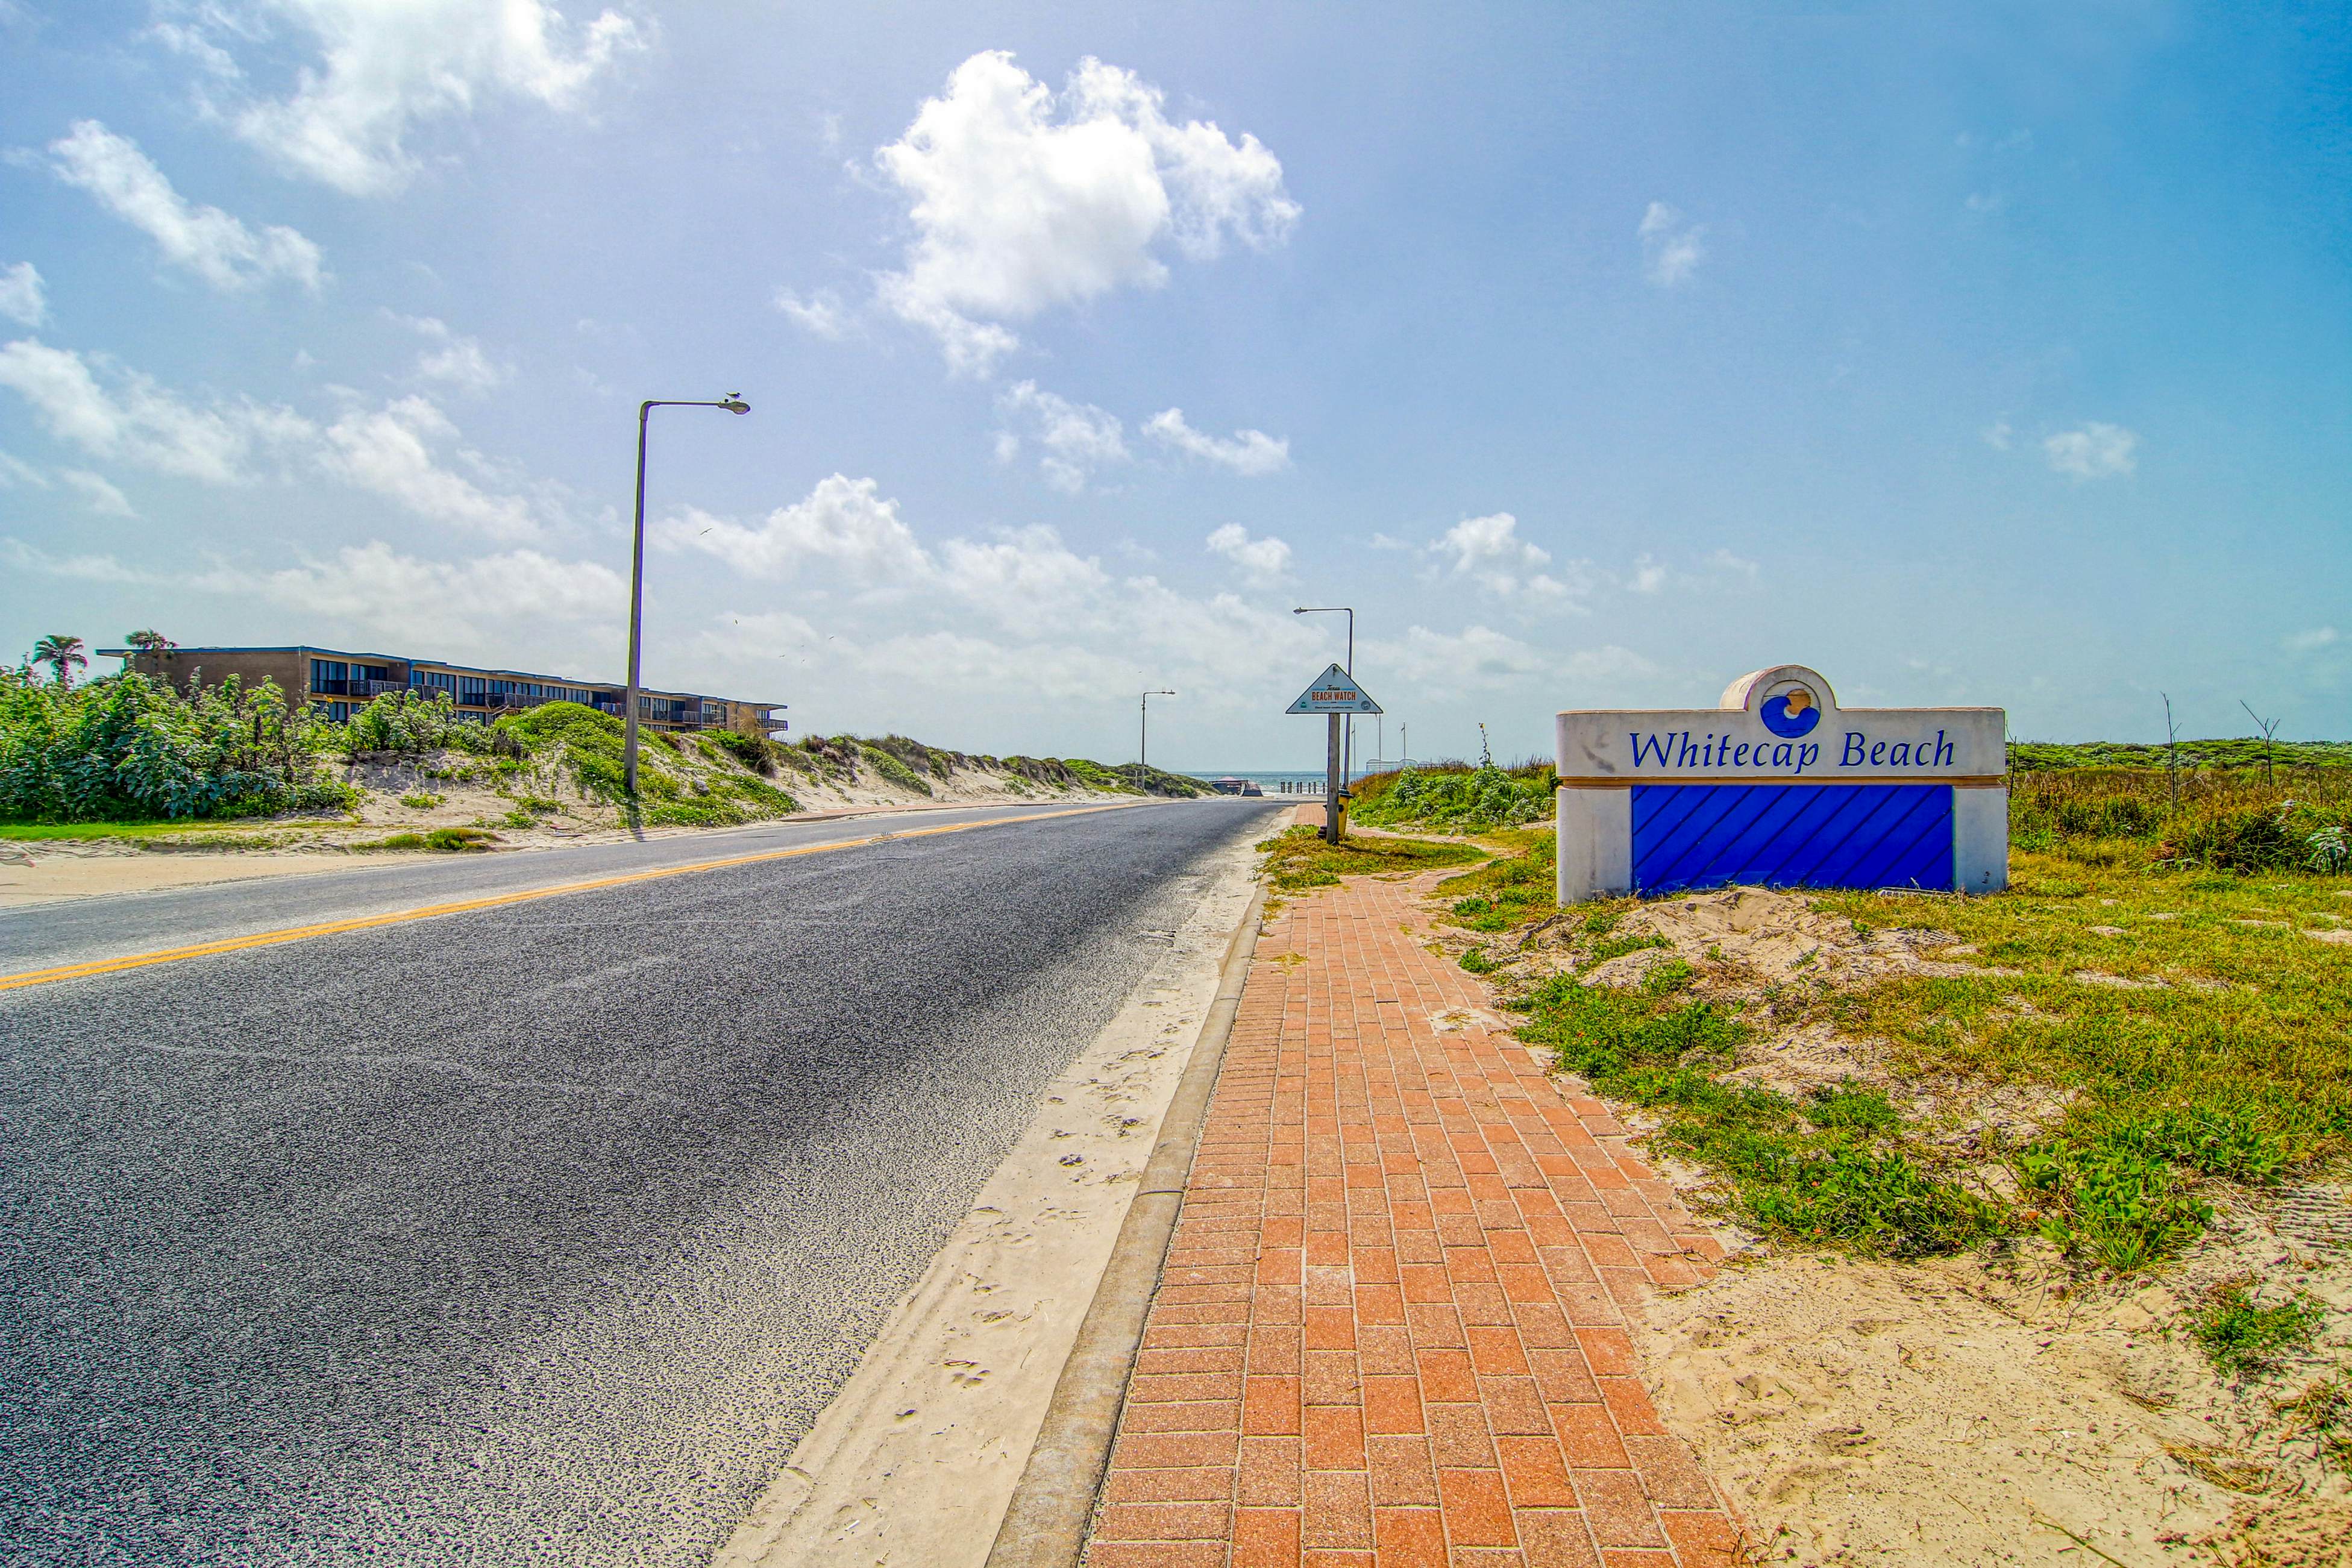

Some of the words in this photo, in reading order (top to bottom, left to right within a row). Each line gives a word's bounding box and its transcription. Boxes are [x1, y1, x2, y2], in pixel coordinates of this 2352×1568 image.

[1312, 691, 1332, 701] BEACH
[1334, 691, 1356, 701] WATCH
[1629, 731, 1819, 774] Whitecap
[1839, 729, 1954, 767] Beach
